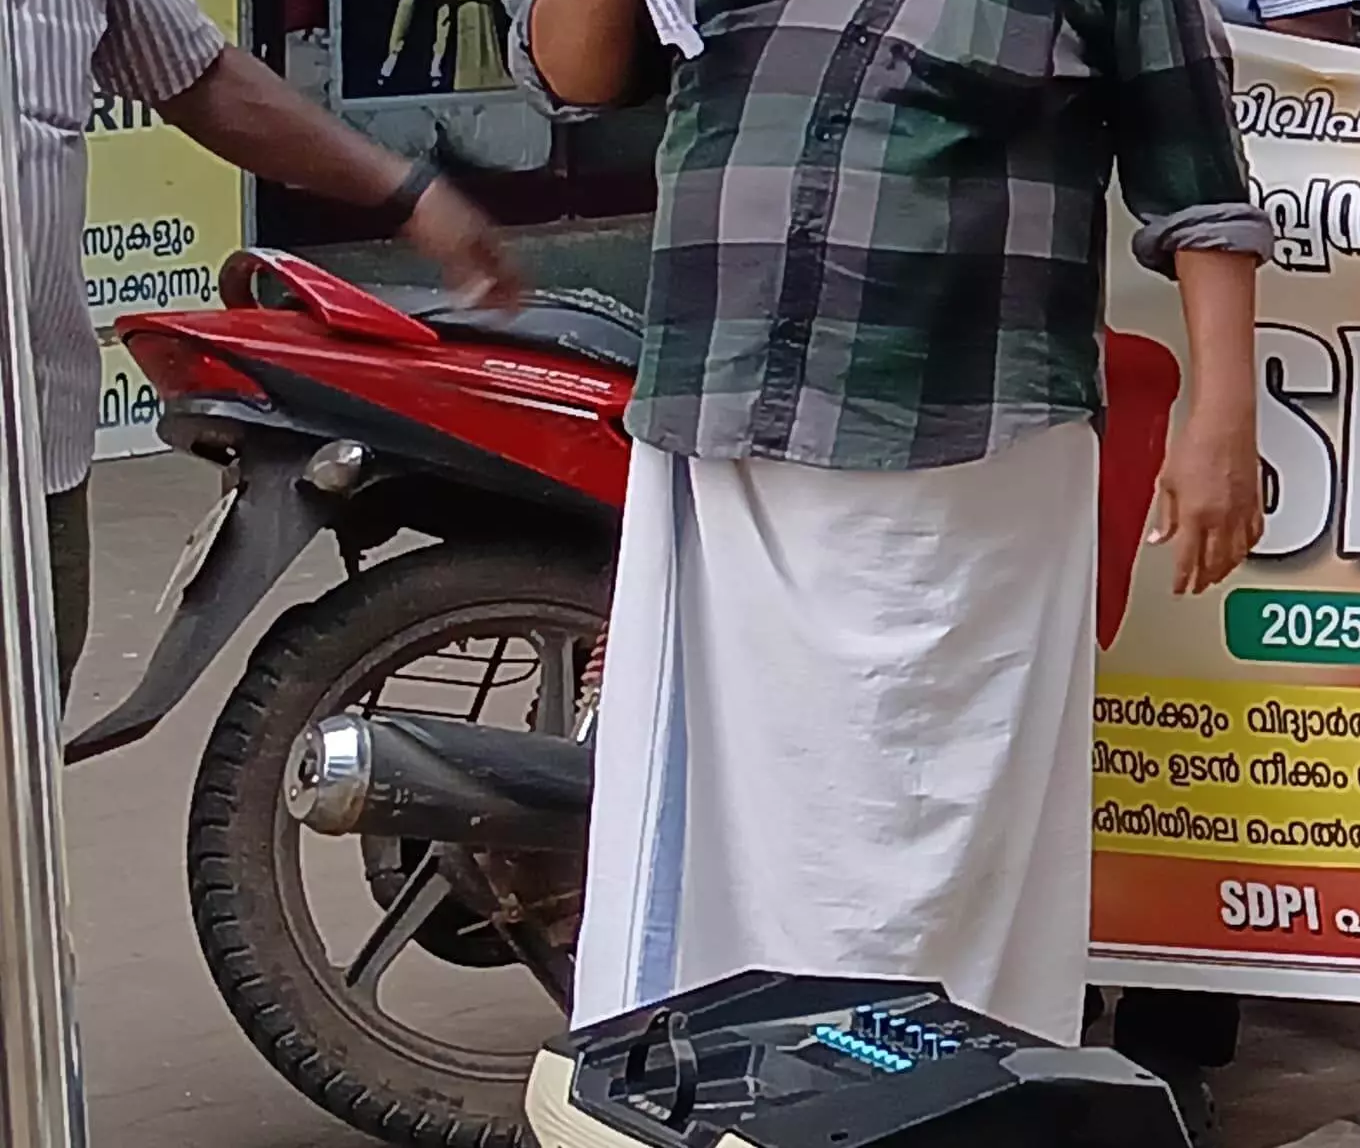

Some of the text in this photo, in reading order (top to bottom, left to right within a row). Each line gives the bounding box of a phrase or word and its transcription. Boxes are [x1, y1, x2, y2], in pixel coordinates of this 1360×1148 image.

[1168, 752, 1241, 787] ഉടൻ
[1250, 752, 1348, 789] നീക്കം
[1219, 880, 1319, 931] SDPI
